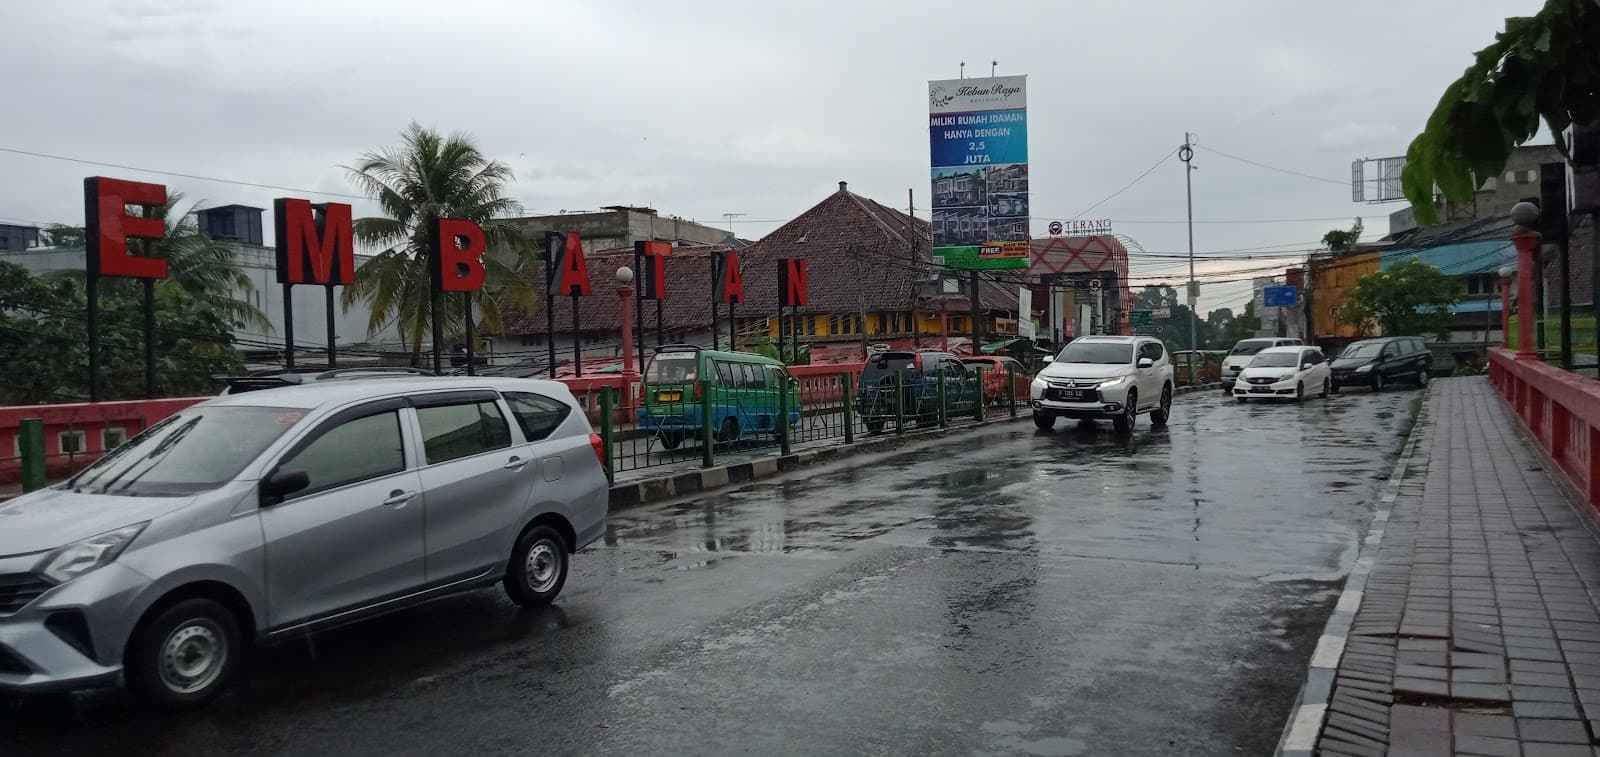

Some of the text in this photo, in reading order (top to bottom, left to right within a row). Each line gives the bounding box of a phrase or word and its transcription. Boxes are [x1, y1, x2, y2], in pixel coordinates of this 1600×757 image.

[956, 84, 1020, 97] Kebun Raya
[931, 113, 1023, 126] MILIKI RUMAH IDAMAN
[944, 128, 1010, 139] HANYA DENGAN
[969, 141, 985, 151] 2,5
[964, 155, 991, 164] JUTA
[1064, 219, 1111, 231] TERANG
[980, 247, 1001, 255] FREE
